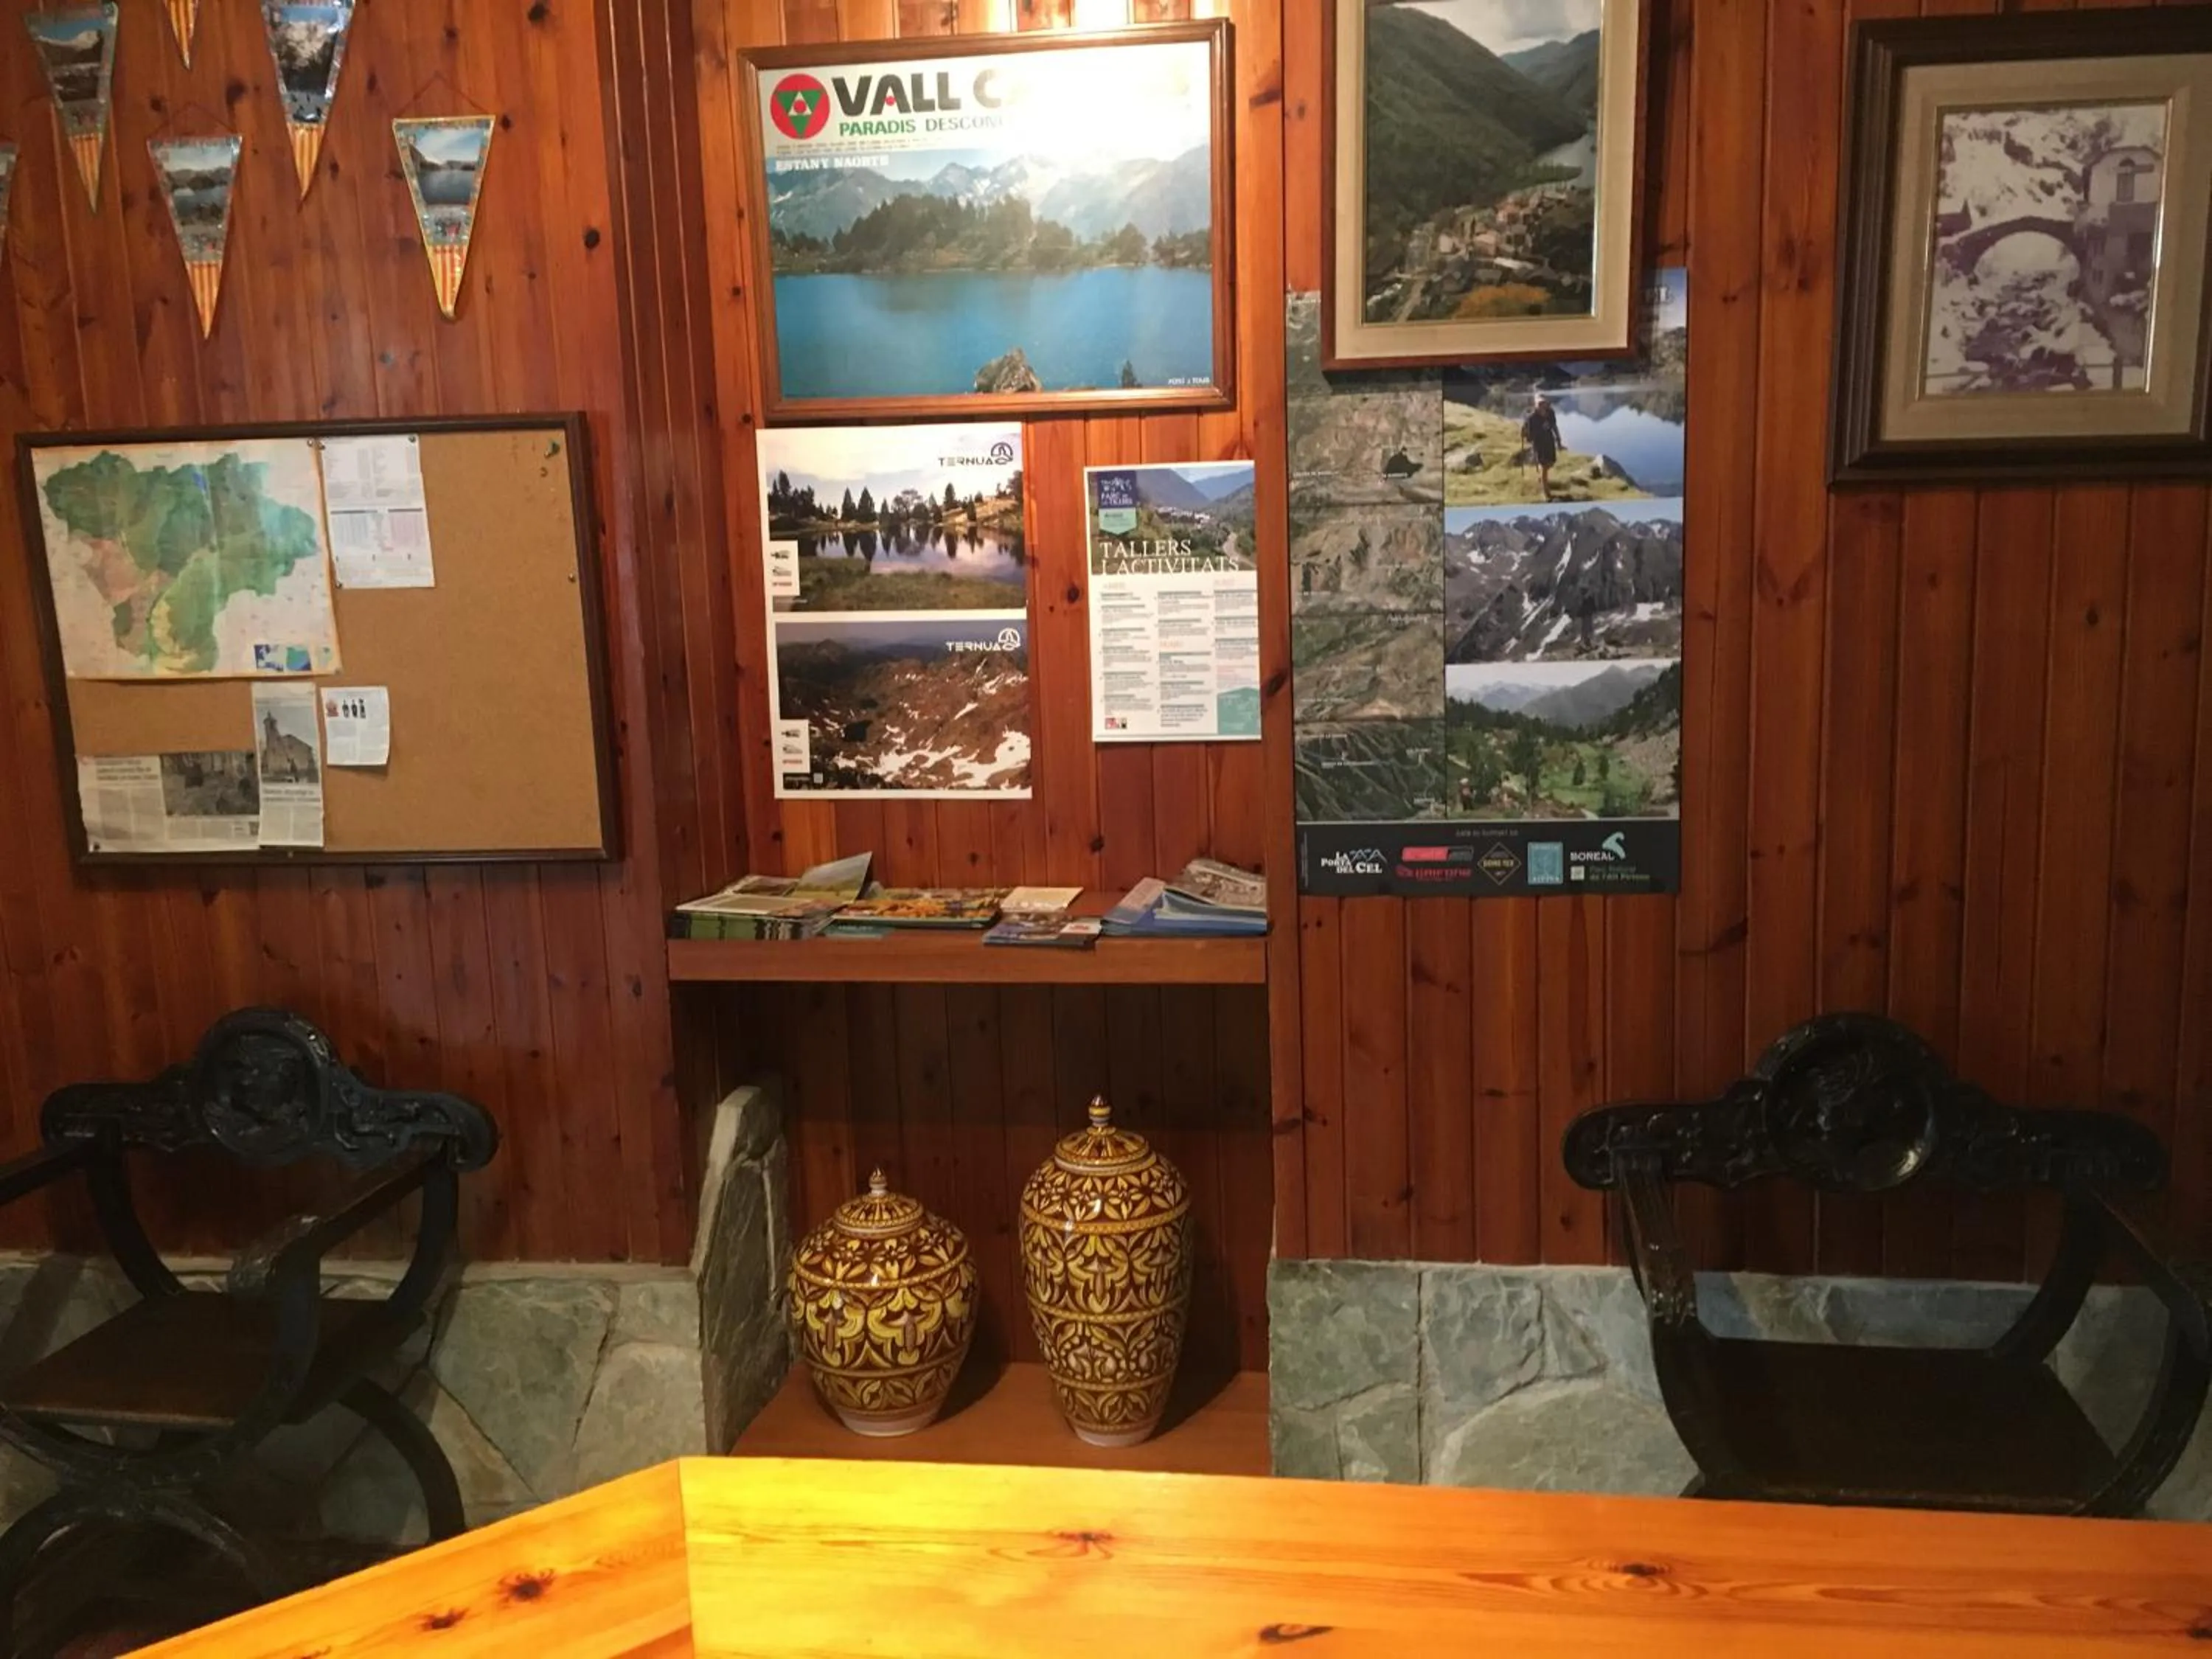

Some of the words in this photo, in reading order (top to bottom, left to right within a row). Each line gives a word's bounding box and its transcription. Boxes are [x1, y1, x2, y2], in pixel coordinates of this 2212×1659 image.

[831, 72, 961, 116] VALL
[838, 119, 917, 136] PARADIS
[925, 114, 1004, 132] DESCON
[938, 456, 993, 467] TERNUA
[1099, 539, 1192, 558] TALLERS
[1116, 556, 1240, 576] ACTIVITATS
[945, 641, 1001, 652] TERNUA
[1570, 852, 1615, 861] BOREAL
[1355, 862, 1382, 874] CEL
